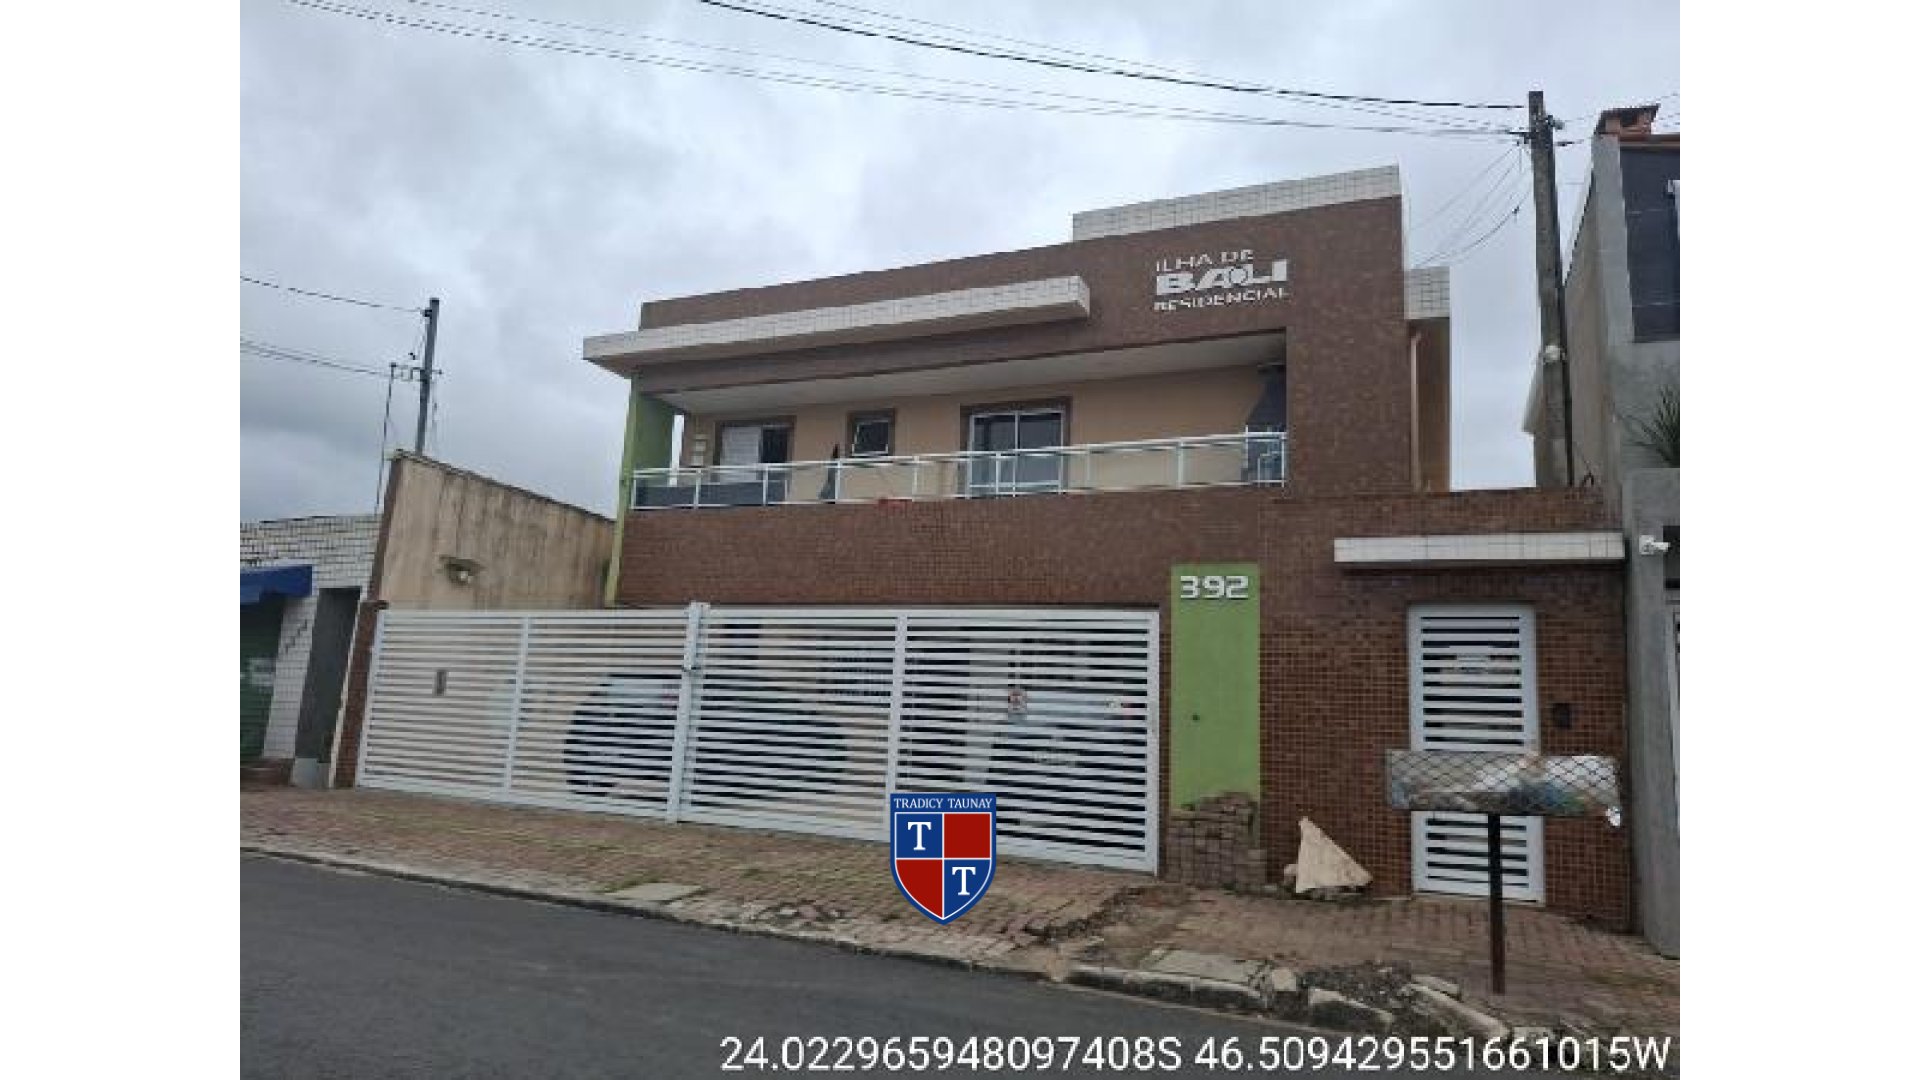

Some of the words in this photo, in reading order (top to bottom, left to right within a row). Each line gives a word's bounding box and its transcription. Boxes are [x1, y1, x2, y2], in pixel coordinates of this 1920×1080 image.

[1156, 253, 1213, 272] ILHA
[1221, 249, 1253, 262] DE
[1154, 287, 1289, 311] RESIDENCIAL
[1180, 575, 1249, 600] 392
